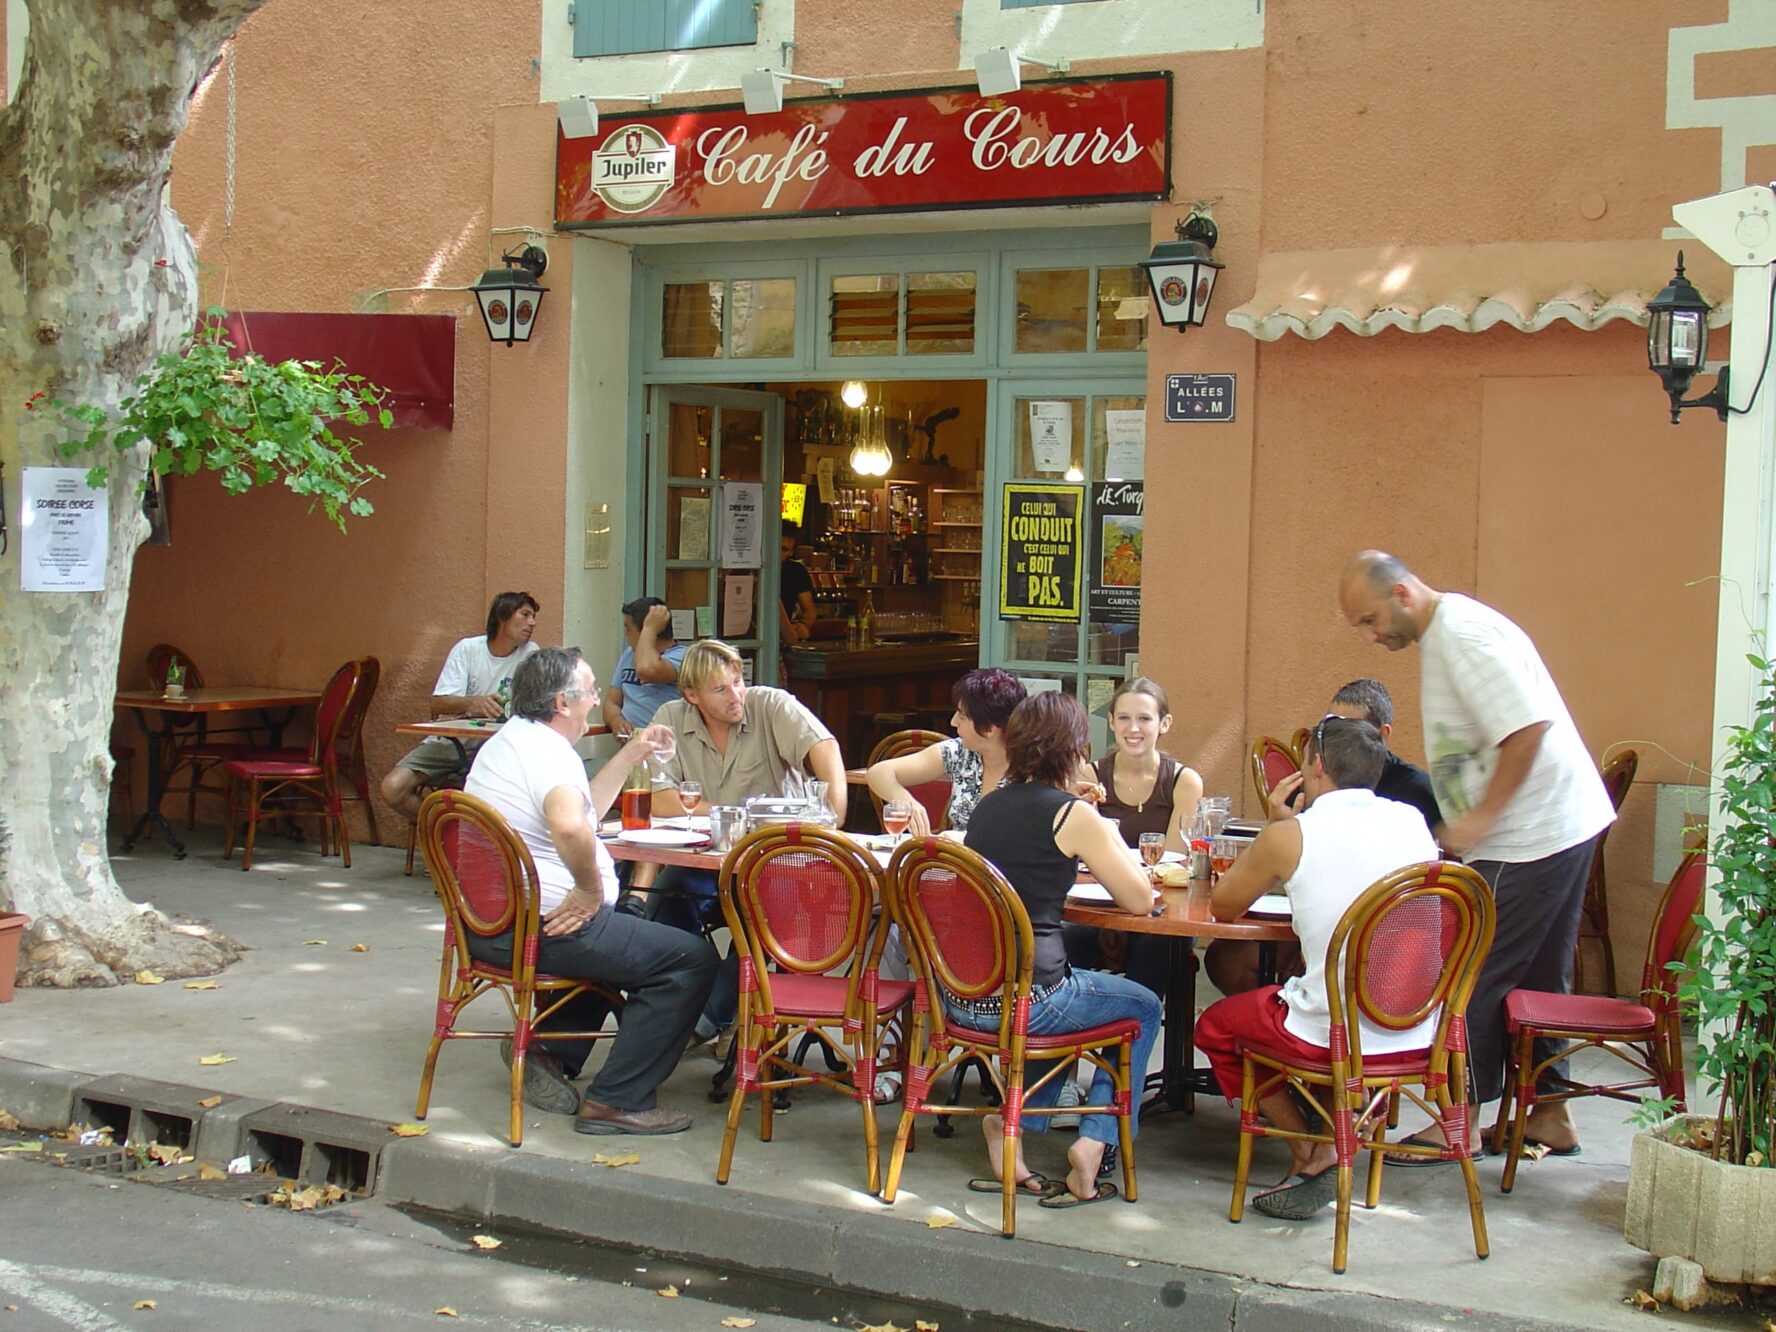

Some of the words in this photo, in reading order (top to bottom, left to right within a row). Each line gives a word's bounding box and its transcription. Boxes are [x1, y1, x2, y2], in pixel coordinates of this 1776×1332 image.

[697, 123, 830, 209] Café
[853, 116, 936, 178] du
[963, 106, 1144, 171] Cours
[601, 157, 667, 180] Jupiler
[1177, 387, 1224, 397] ALLÉES
[68, 500, 95, 510] CORSE
[1021, 502, 1042, 515] CELUI
[1043, 502, 1057, 516] QUI
[1011, 516, 1073, 542] CONDUIT
[1024, 544, 1039, 554] C'EST
[1040, 544, 1057, 555] CELUI
[1058, 544, 1070, 556] QUI
[1016, 562, 1026, 573] NE
[1029, 556, 1054, 574] BOIT
[1028, 575, 1064, 606] PAS.
